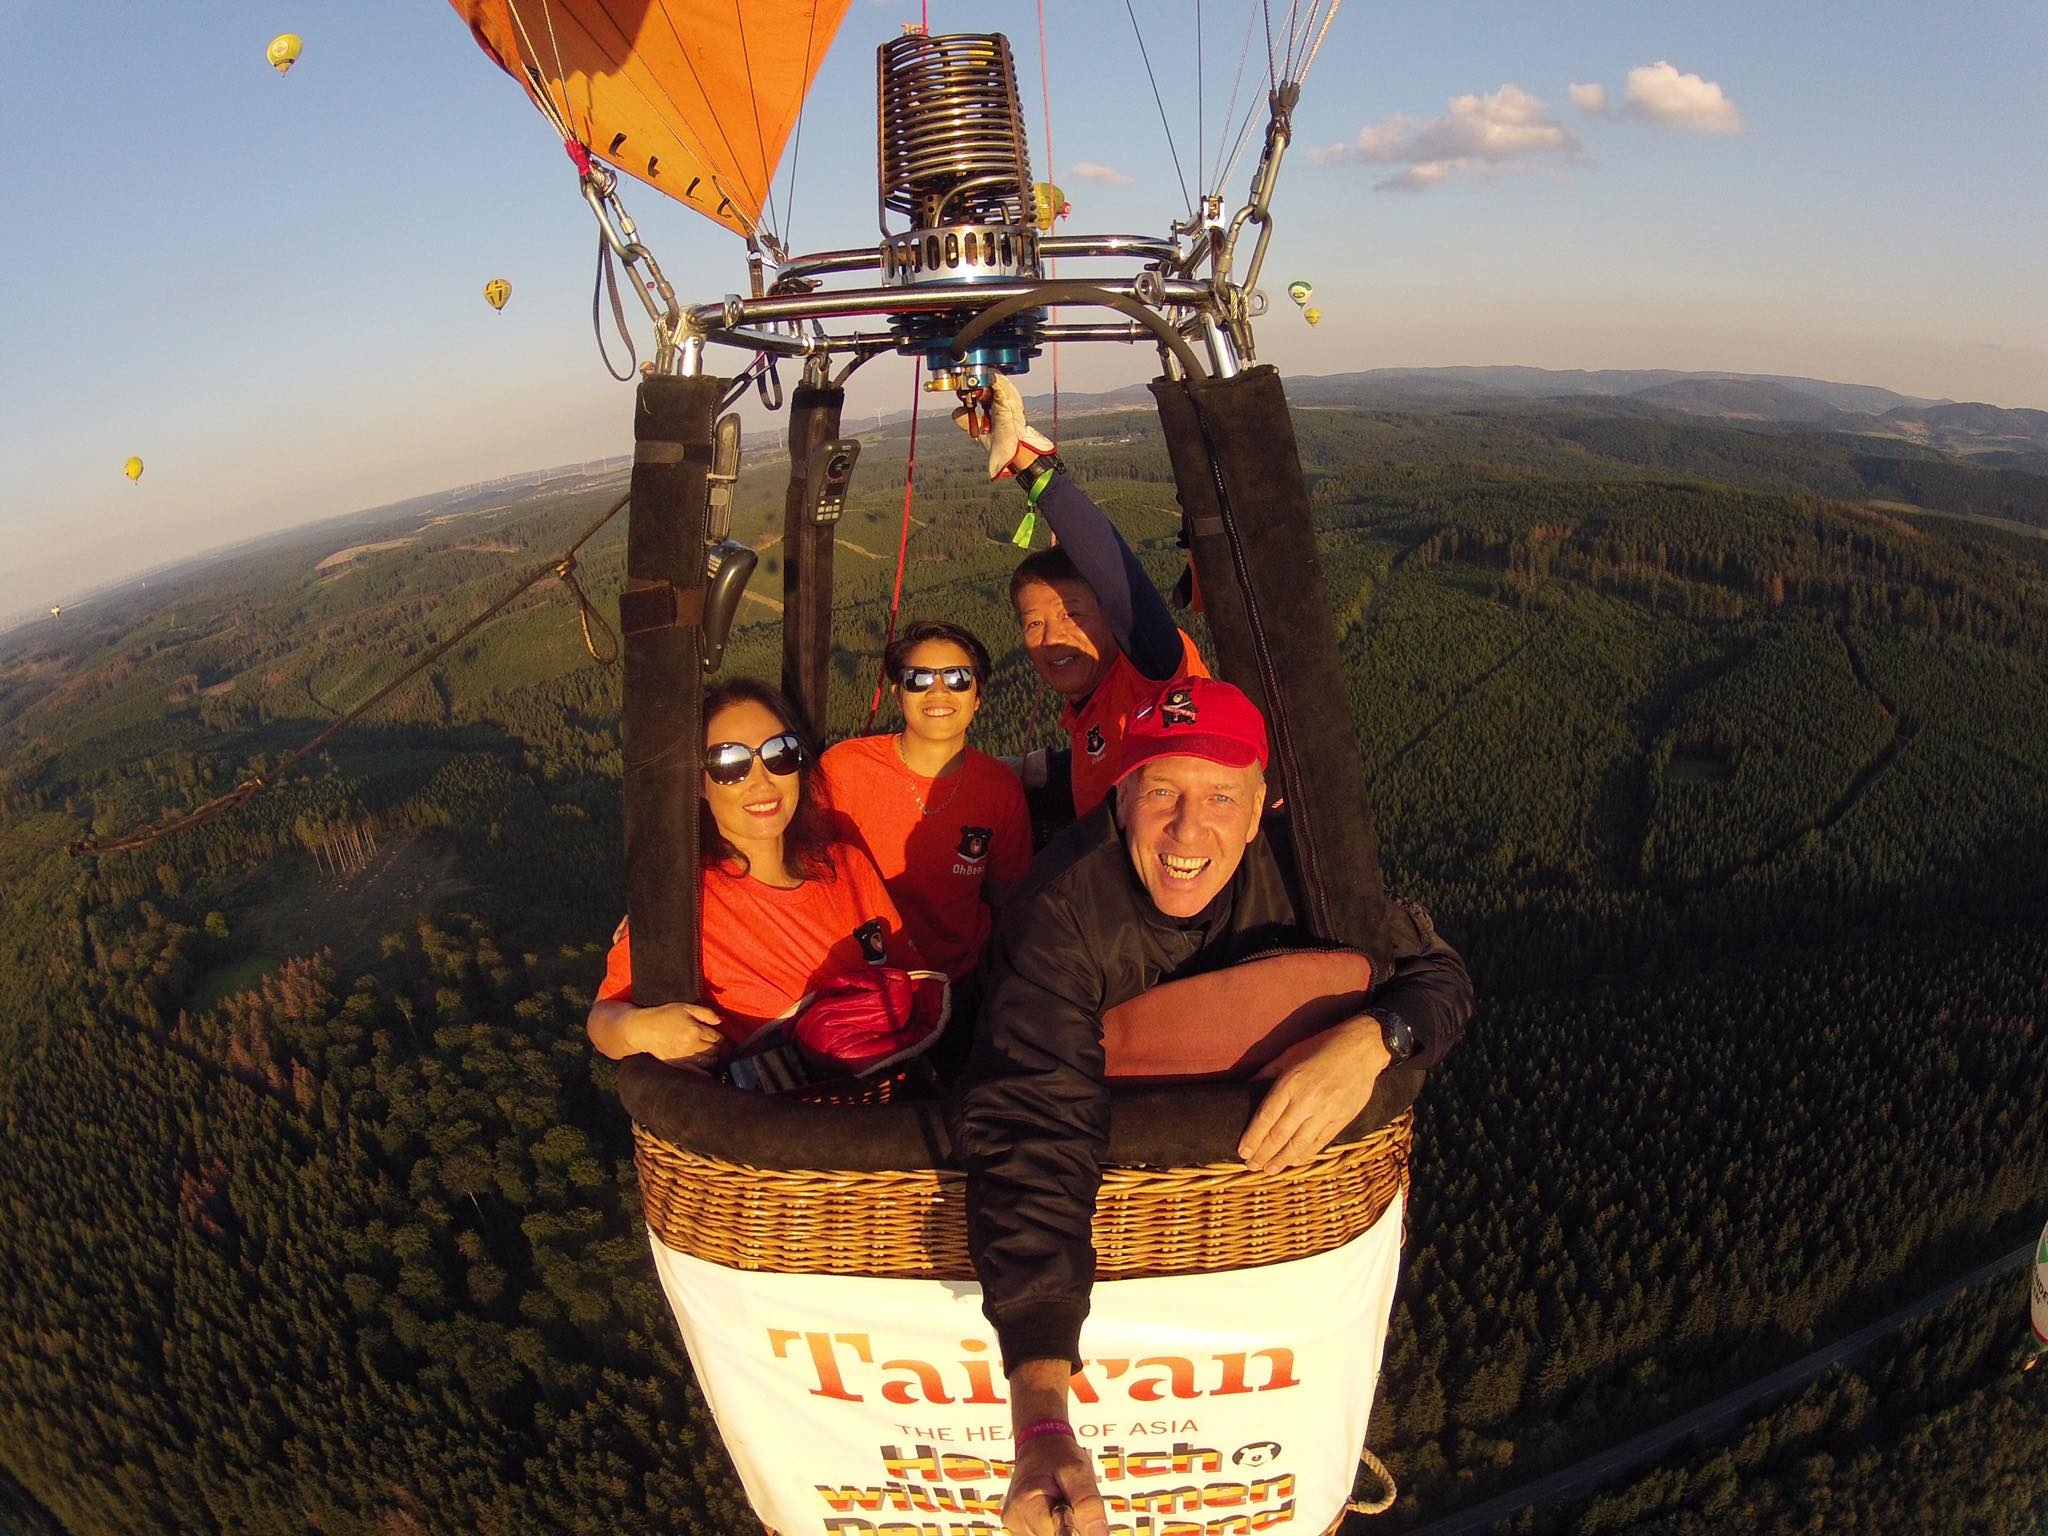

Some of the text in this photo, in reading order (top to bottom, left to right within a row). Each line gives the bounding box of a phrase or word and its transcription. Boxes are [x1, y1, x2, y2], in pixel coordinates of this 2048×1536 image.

[895, 1423, 955, 1442] THE
[1079, 1423, 1117, 1437] OF
[1128, 1418, 1199, 1437] ASIA
